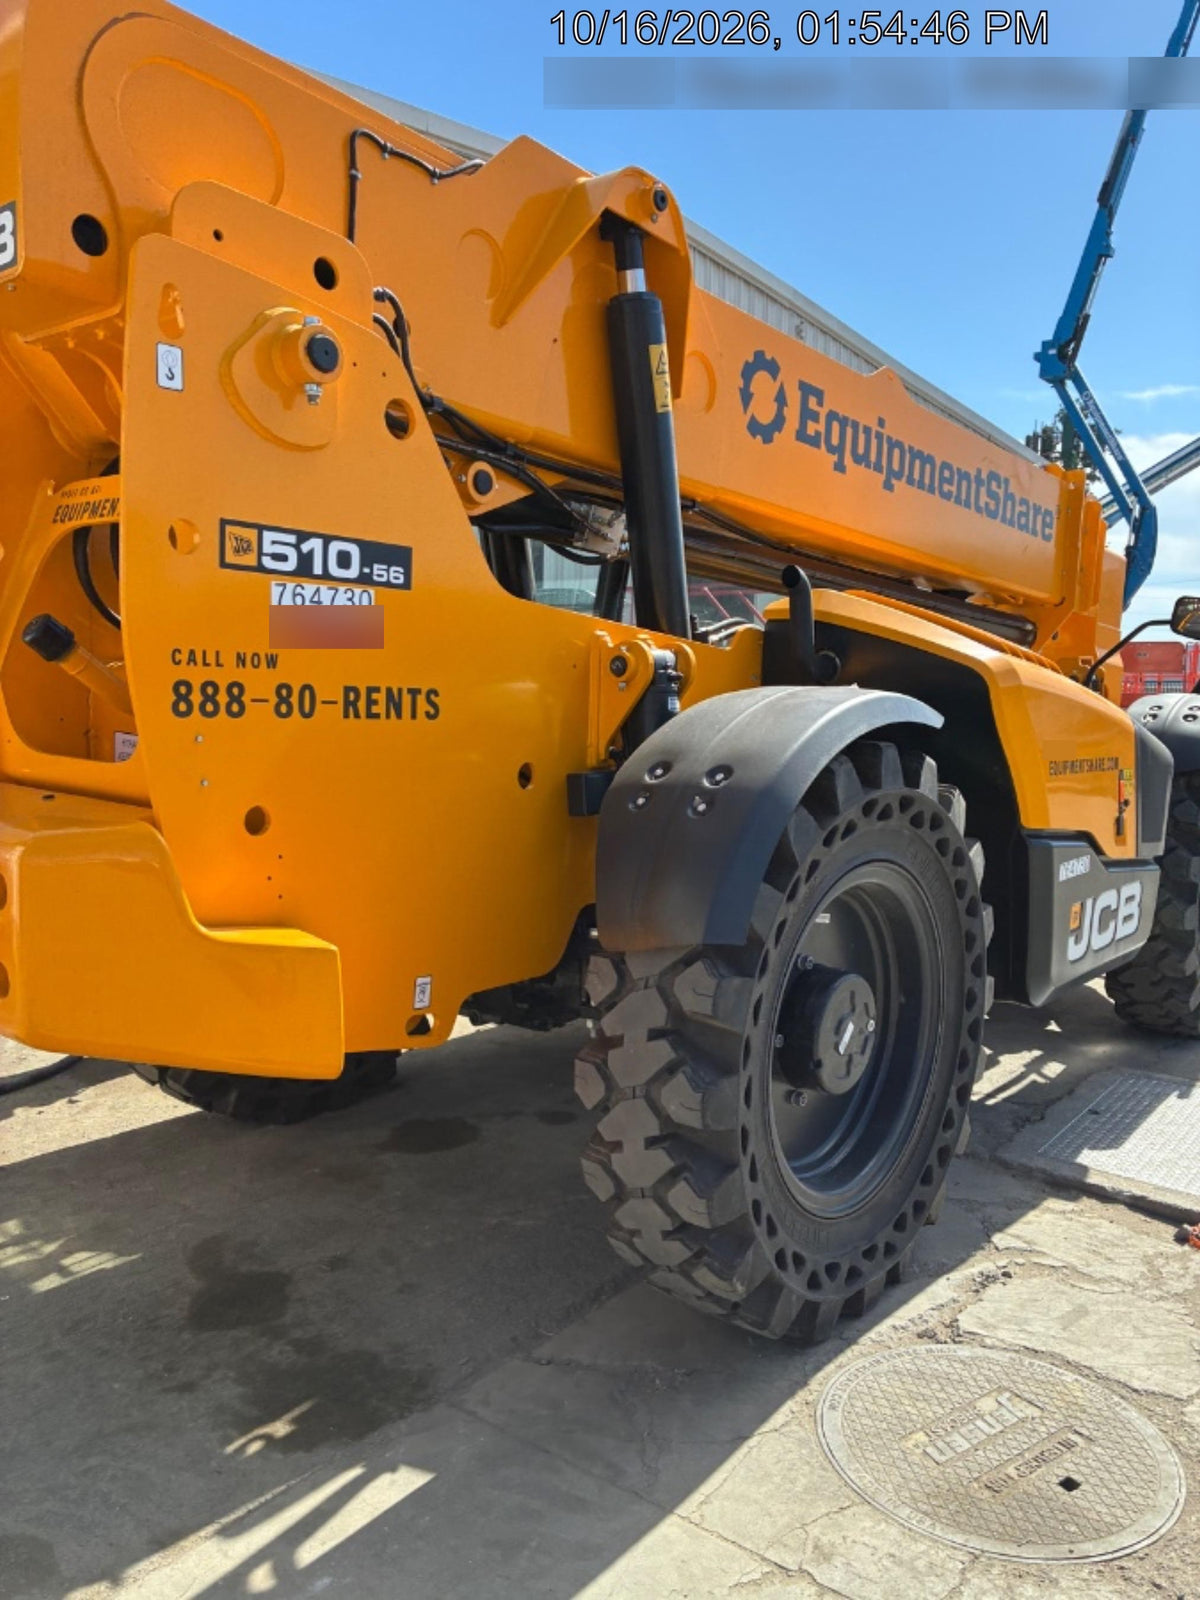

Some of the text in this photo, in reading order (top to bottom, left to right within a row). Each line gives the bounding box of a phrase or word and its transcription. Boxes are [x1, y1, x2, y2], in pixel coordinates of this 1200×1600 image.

[795, 379, 1055, 542] EquipmentShare
[51, 498, 120, 524] EQUIPMEN
[260, 529, 405, 584] 510-56
[171, 648, 280, 670] CALL NOW
[170, 678, 441, 721] 888-80-RENTS
[1049, 756, 1120, 777] EQUIPMENTSHARE.COM
[1066, 879, 1143, 963] JCB
